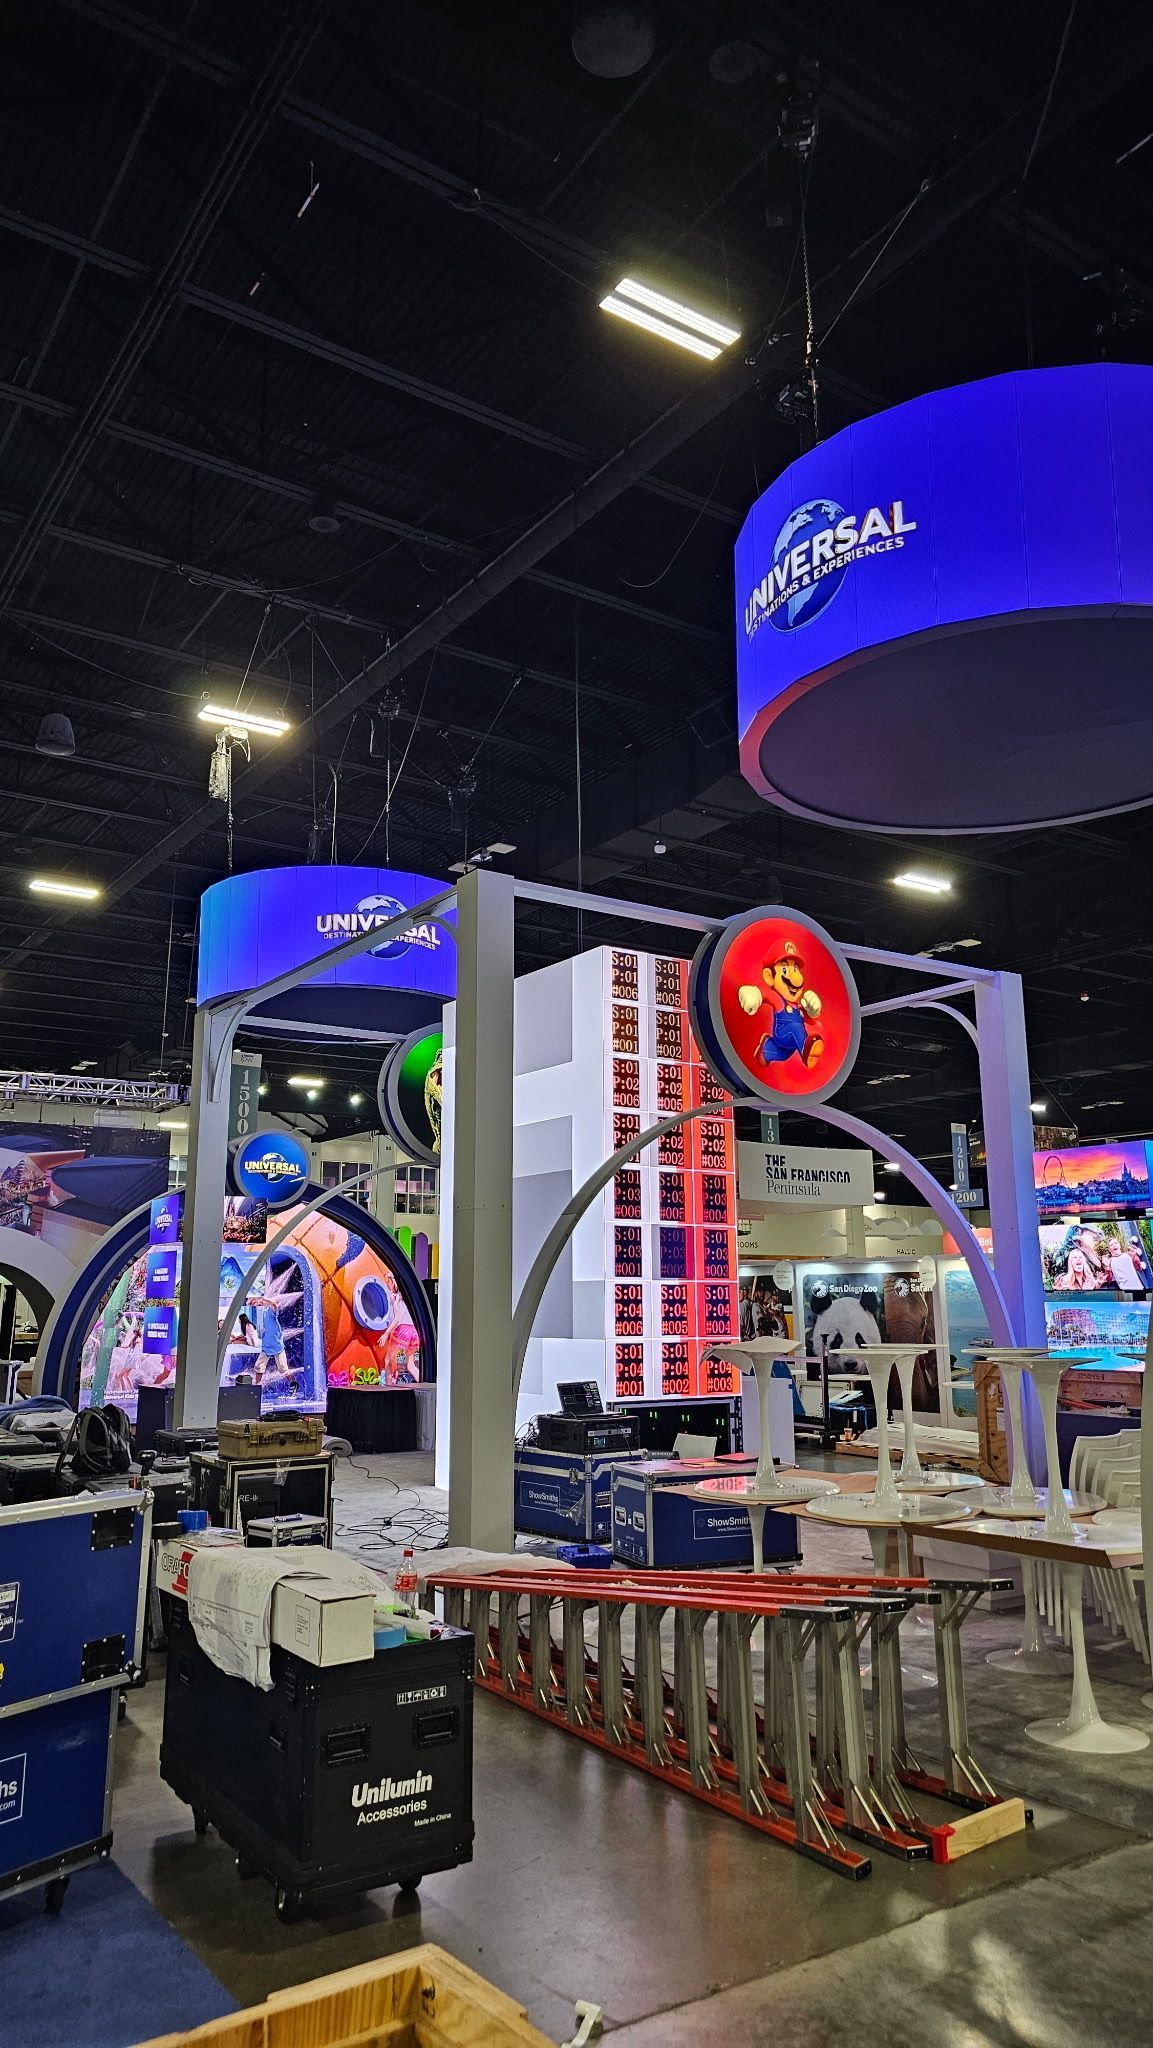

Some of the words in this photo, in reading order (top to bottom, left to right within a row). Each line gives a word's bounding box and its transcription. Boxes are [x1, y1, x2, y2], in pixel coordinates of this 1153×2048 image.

[745, 501, 917, 635] UNIVERSAL
[802, 573, 811, 586] &
[813, 536, 905, 581] EXPERIENCES
[316, 913, 441, 946] UNIVESAL
[391, 936, 436, 951] XPERIENCES
[612, 953, 638, 968] S:01
[656, 960, 680, 975] S:01
[612, 969, 638, 984] P:01
[656, 976, 680, 990] P:01
[612, 985, 638, 999] #006
[656, 991, 681, 1006] #005
[612, 1006, 638, 1020] S:01
[656, 1012, 680, 1026] S:01
[612, 1022, 638, 1036] P:01
[656, 1028, 681, 1042] P:01
[613, 1038, 639, 1052] #001
[657, 1043, 682, 1058] #002
[613, 1060, 639, 1074] S:01
[657, 1065, 682, 1079] S:01
[613, 1076, 639, 1090] P:02
[657, 1081, 682, 1095] P:02
[613, 1092, 640, 1107] #006
[700, 1086, 724, 1099] P:02
[237, 1069, 250, 1134] 1500
[658, 1098, 683, 1111] #005
[614, 1115, 639, 1128] S:01
[700, 1122, 725, 1136] S:01
[658, 1135, 683, 1148] P:02
[701, 1138, 725, 1152] P:02
[659, 1152, 683, 1166] #002
[701, 1155, 726, 1168] #003
[765, 1154, 785, 1166] THE
[957, 1135, 965, 1182] 1200
[244, 1161, 301, 1174] UNIVERSAL
[614, 1171, 640, 1184] S:01
[659, 1173, 684, 1186] S:01
[766, 1167, 787, 1179] SAN
[791, 1169, 851, 1183] FRANCISCO
[703, 1176, 726, 1189] S:01
[767, 1180, 821, 1196] Peninsula
[614, 1188, 640, 1201] P:03
[660, 1190, 684, 1203] P:03
[615, 1205, 640, 1218] #006
[660, 1208, 685, 1220] #005
[704, 1210, 727, 1222] #004
[615, 1228, 640, 1241] S:01
[704, 1231, 727, 1244] S:01
[615, 1245, 641, 1258] P:03
[704, 1248, 728, 1260] P:03
[615, 1263, 641, 1276] #001
[615, 1286, 642, 1300] S:01
[661, 1286, 686, 1300] S:01
[705, 1286, 729, 1300] S:01
[828, 1285, 843, 1293] San
[844, 1284, 863, 1295] Diego
[864, 1285, 878, 1293] Zoo
[615, 1303, 643, 1317] P:04
[661, 1303, 688, 1317] P:04
[705, 1303, 730, 1317] P:04
[615, 1321, 643, 1334] #006
[661, 1320, 688, 1334] #005
[705, 1320, 731, 1334] #004
[616, 1345, 643, 1359] S:01
[662, 1345, 688, 1358] S:01
[616, 1363, 643, 1377] P:04
[662, 1362, 689, 1376] P:04
[706, 1361, 732, 1374] P:04
[616, 1381, 644, 1396] #001
[662, 1380, 689, 1394] #002
[707, 1378, 733, 1392] #003
[528, 1490, 558, 1503] ShowSmiths
[351, 1769, 433, 1808] Unilumin
[356, 1799, 427, 1826] Accessories
[414, 1817, 429, 1827] Made
[436, 1812, 452, 1822] China
